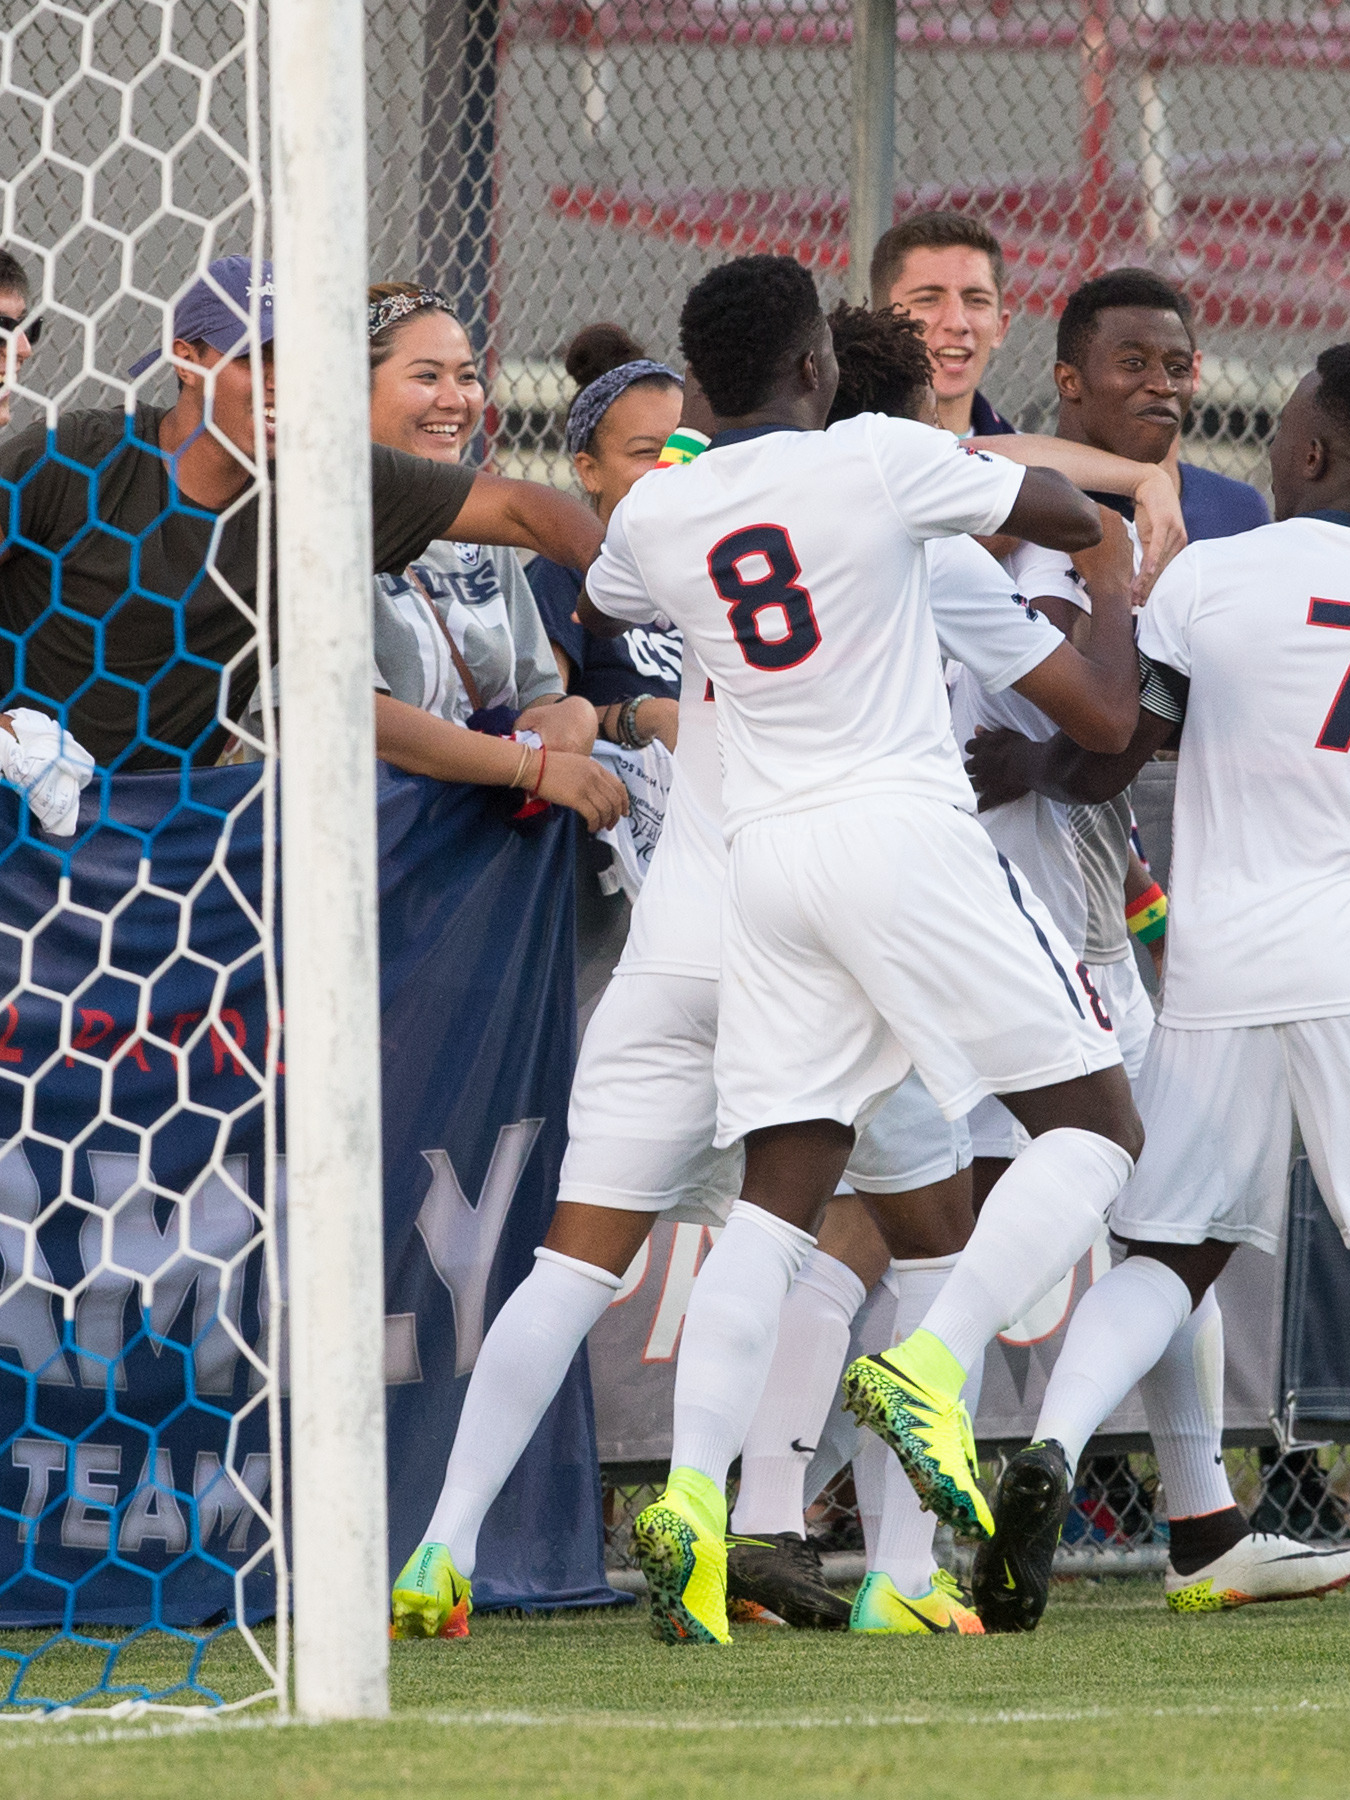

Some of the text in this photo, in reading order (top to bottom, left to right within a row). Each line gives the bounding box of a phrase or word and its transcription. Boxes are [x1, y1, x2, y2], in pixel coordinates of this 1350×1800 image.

[706, 523, 822, 672] 8
[1076, 961, 1113, 1031] 8
[12, 1439, 271, 1552] TEAM
